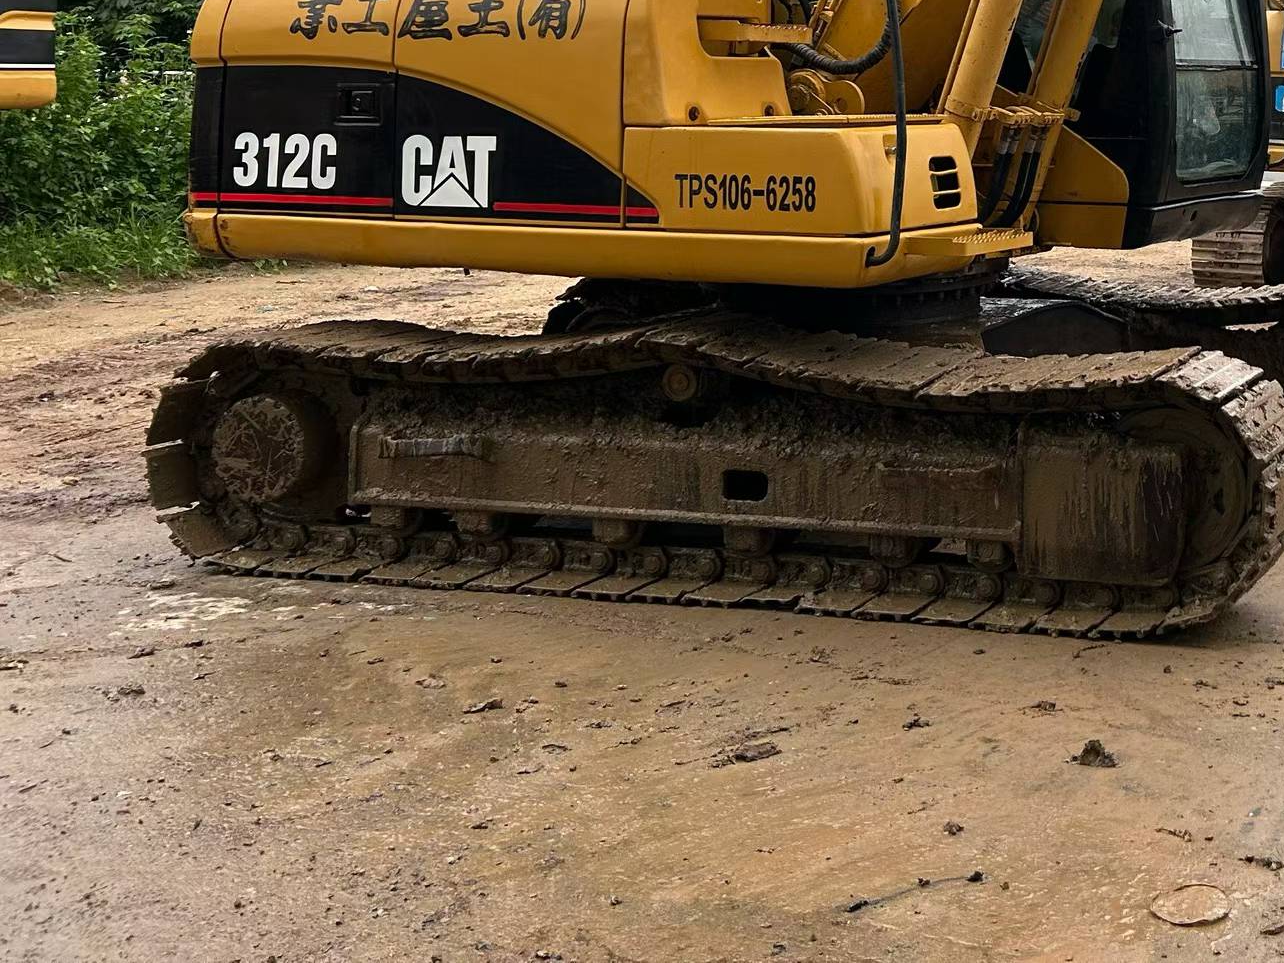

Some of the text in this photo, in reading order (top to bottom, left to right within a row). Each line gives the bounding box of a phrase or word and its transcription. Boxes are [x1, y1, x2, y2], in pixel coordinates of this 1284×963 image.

[232, 131, 338, 190] 312C
[401, 133, 497, 208] CAT
[674, 173, 817, 212] TPS106-6258
